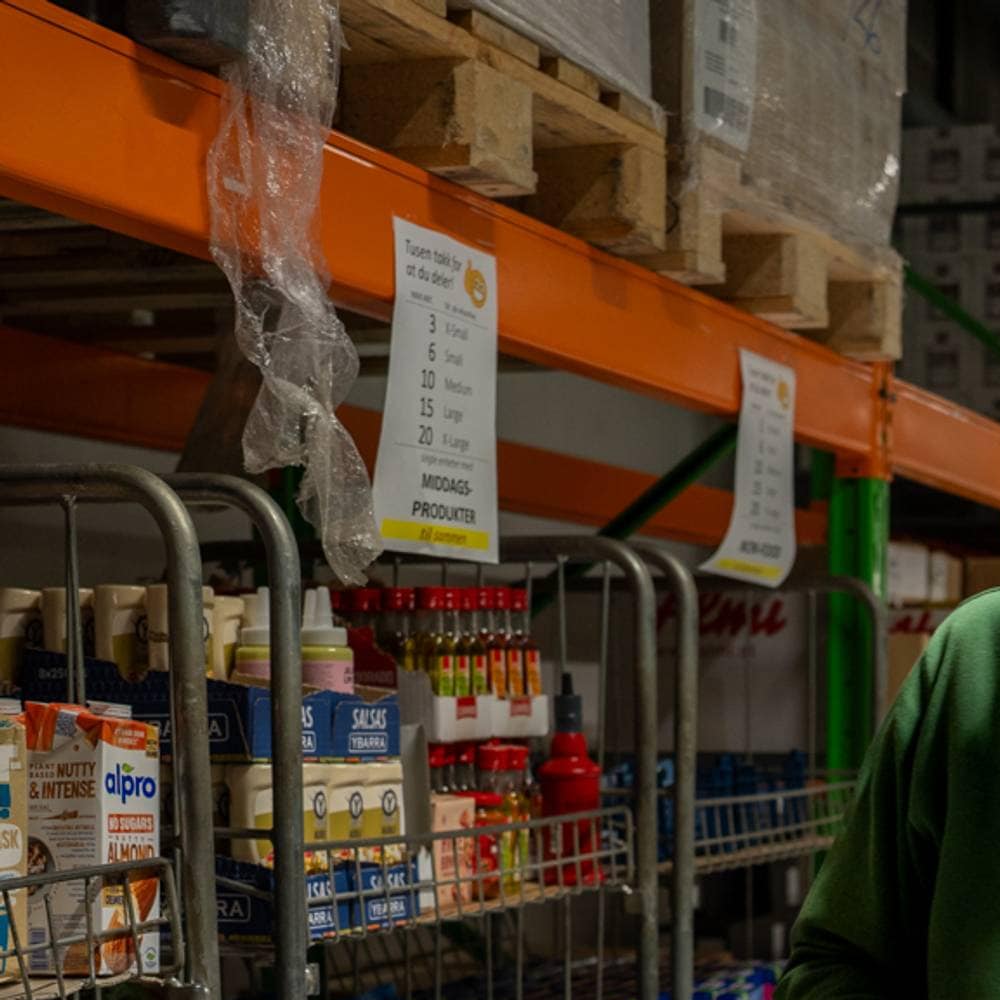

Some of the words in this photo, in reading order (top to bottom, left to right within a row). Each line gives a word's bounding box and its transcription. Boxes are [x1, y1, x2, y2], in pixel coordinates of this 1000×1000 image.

[418, 266, 430, 283] du
[429, 313, 437, 335] 3
[427, 342, 437, 362] 6
[444, 349, 464, 368] Small
[421, 369, 436, 390] 10
[444, 377, 473, 396] Medium
[419, 397, 434, 419] 15
[443, 404, 464, 423] Large
[418, 425, 434, 447] 20
[420, 472, 474, 497] MIDDAGS-
[411, 499, 477, 526] PRODUKTER
[352, 707, 388, 730] SALSAS
[351, 734, 387, 751] YBARRA
[56, 761, 97, 779] NUTTY
[29, 781, 40, 800] &
[41, 780, 97, 800] INTENSE
[105, 762, 157, 805] alpro
[0, 829, 19, 849] SK
[107, 841, 155, 865] ALMOND
